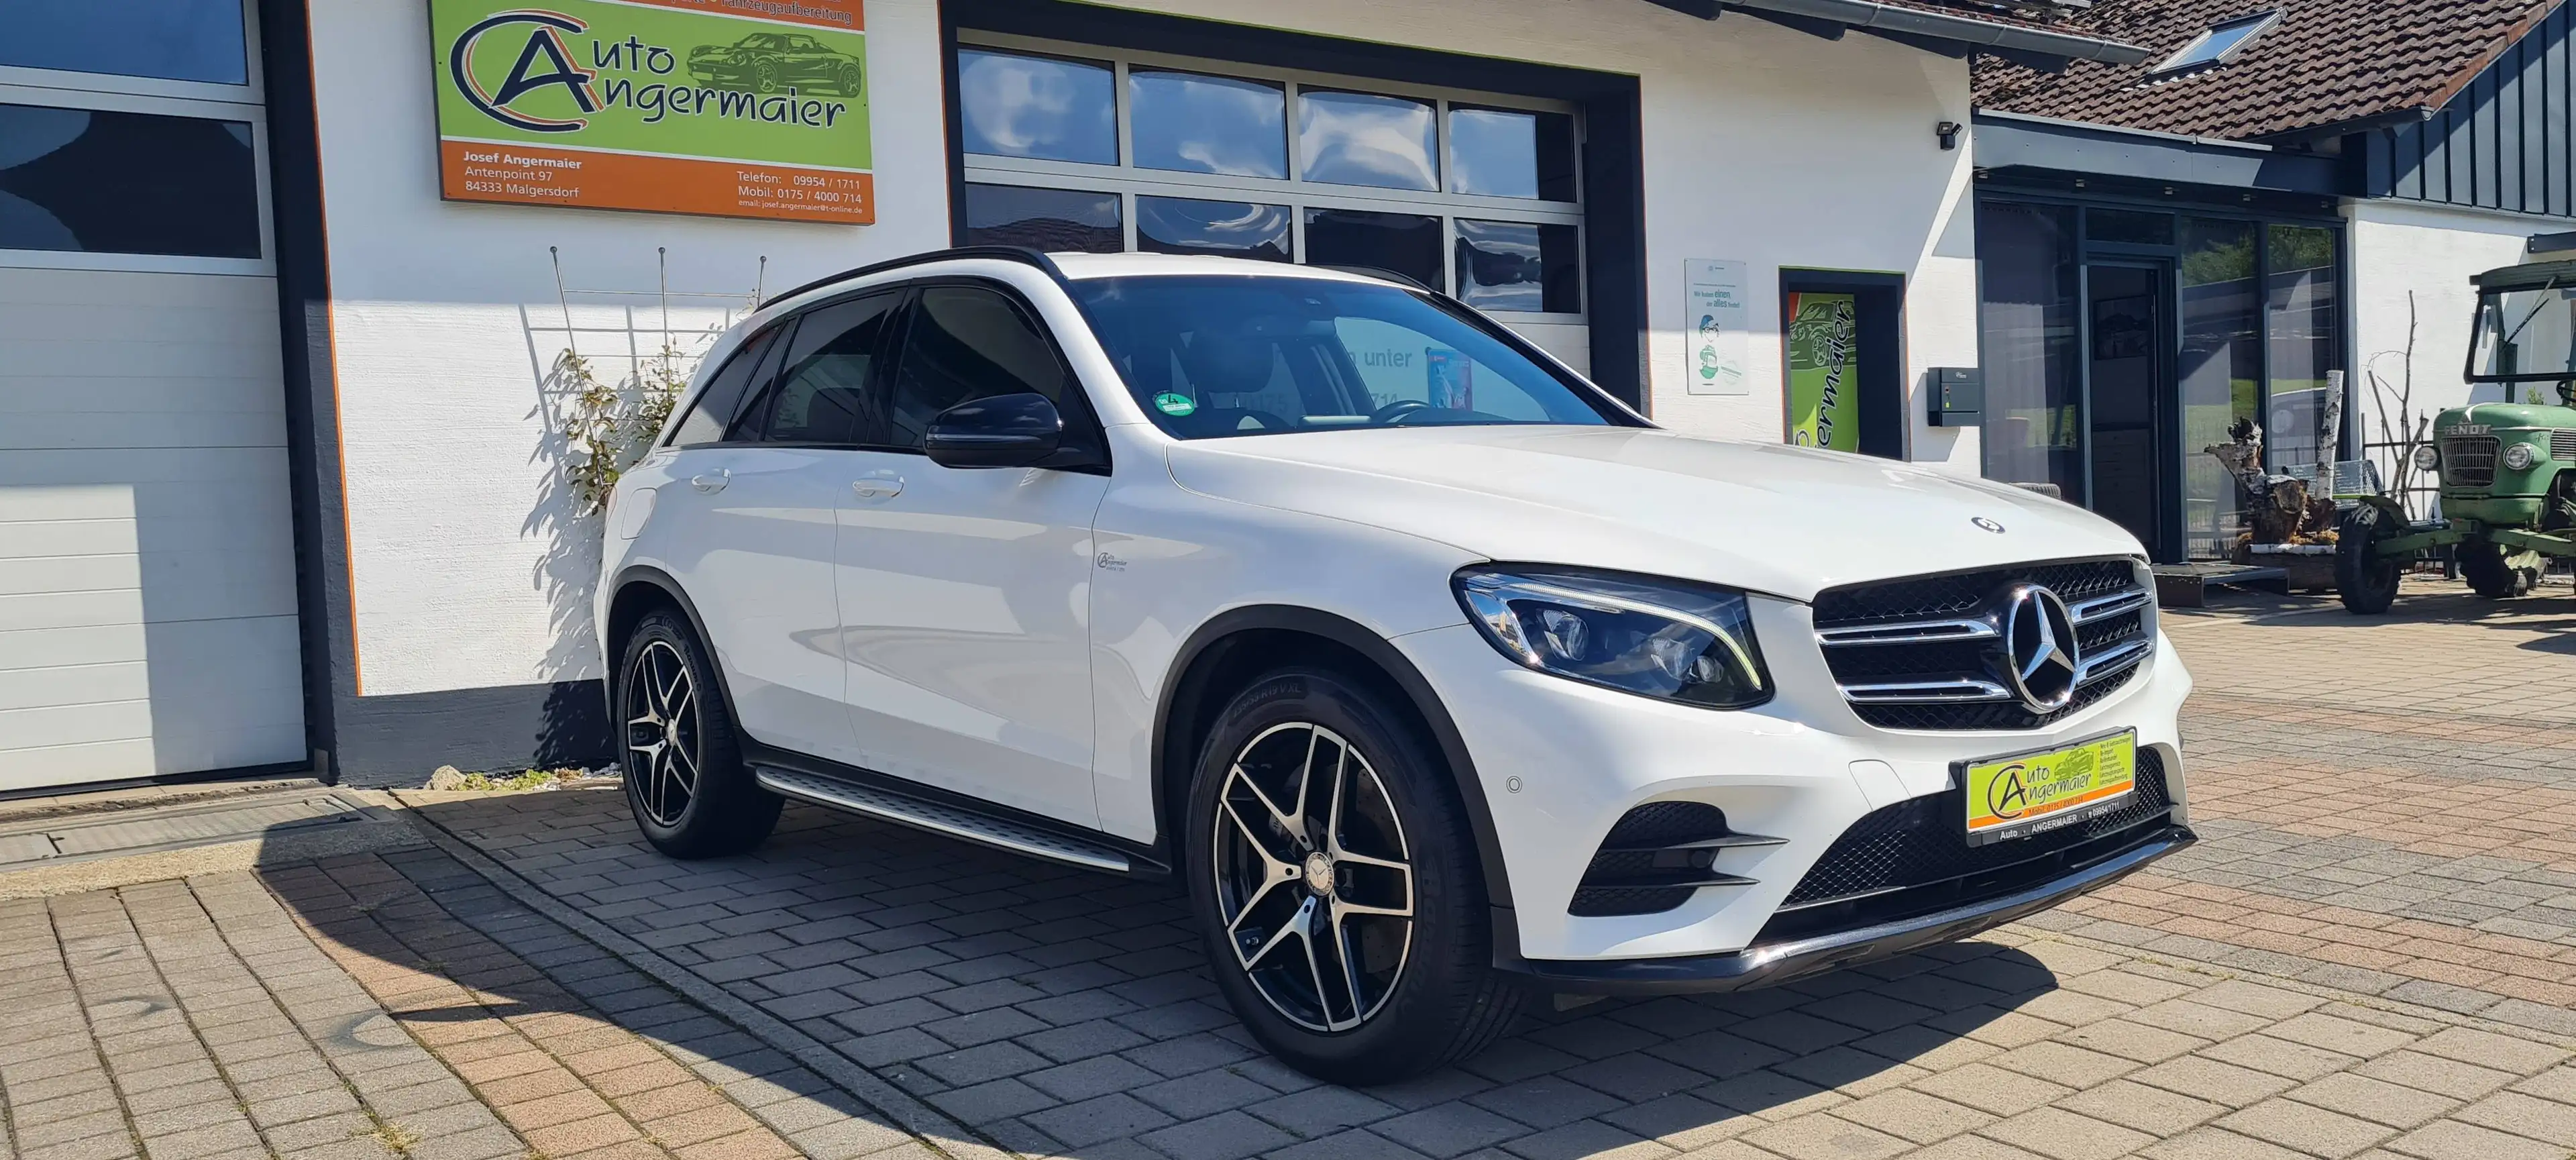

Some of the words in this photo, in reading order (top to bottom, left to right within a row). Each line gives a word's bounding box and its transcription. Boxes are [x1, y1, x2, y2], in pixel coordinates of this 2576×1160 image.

[464, 151, 499, 163] Josef
[503, 154, 582, 169] Angermaier
[465, 166, 535, 180] Antenpoint
[539, 171, 552, 181] 97
[737, 171, 782, 184] Telefon:
[794, 175, 825, 187] 09954
[828, 178, 833, 188] /
[837, 179, 860, 190] 1711
[466, 180, 502, 193] 84333
[506, 183, 579, 197] Malgersdorf
[738, 186, 773, 198] Mobil:
[777, 189, 803, 200] 0175
[806, 191, 811, 201] /
[814, 191, 839, 202] 4000
[843, 193, 862, 203] 714
[762, 201, 863, 214] josef.angermaier@t-online.de
[1364, 348, 1412, 367] unter
[1817, 300, 1851, 448] ermaier
[1168, 394, 1178, 404] 4
[2445, 424, 2491, 435] FENDT
[2000, 831, 2018, 841] Auto
[2031, 814, 2078, 834] ANGERMAIER
